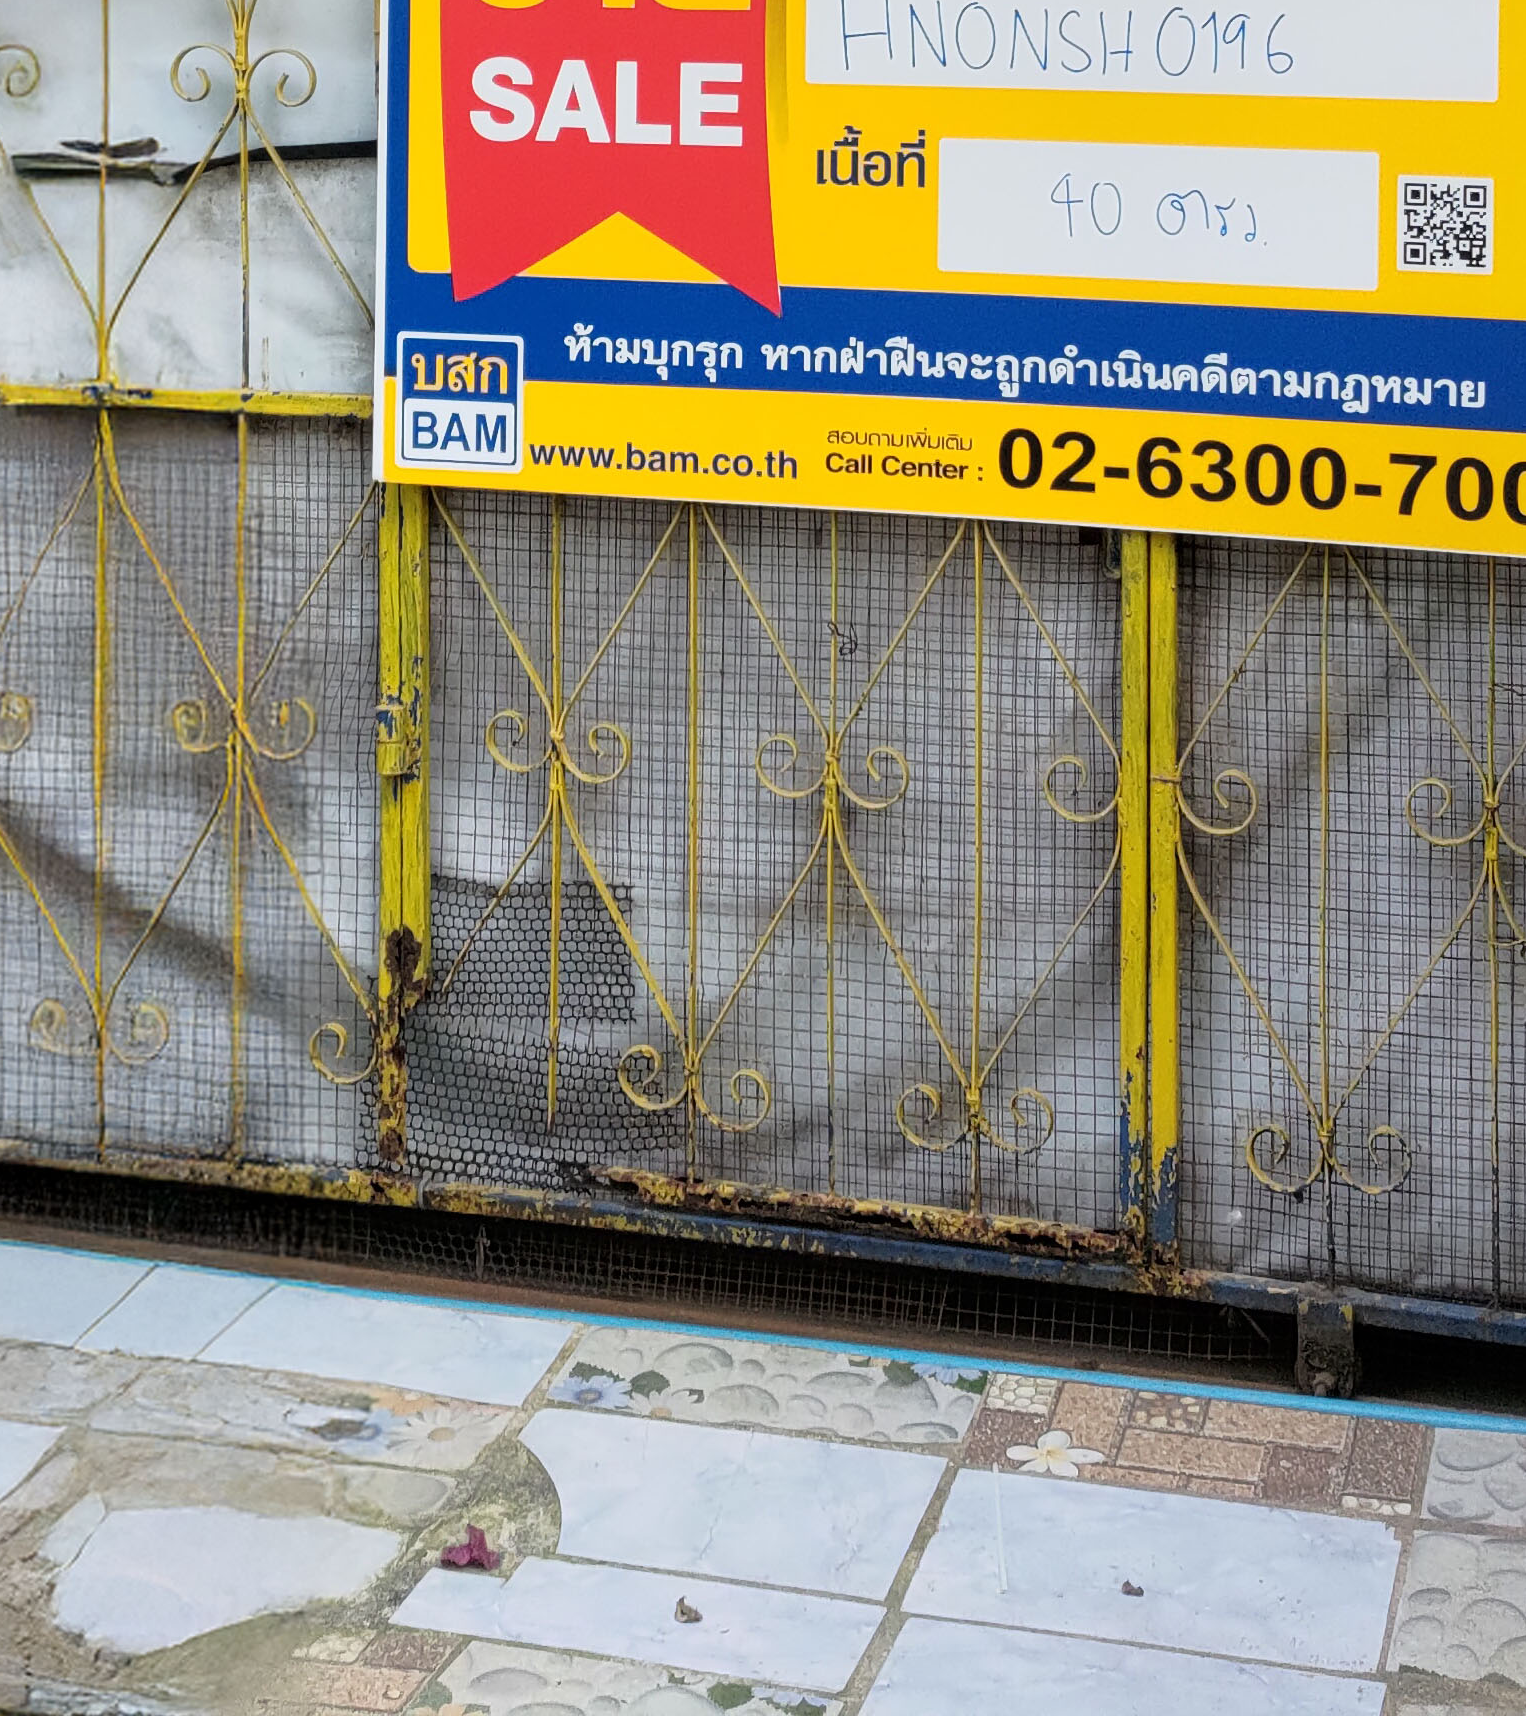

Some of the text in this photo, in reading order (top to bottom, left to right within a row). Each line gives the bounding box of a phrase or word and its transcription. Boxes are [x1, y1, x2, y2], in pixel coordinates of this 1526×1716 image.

[469, 56, 743, 147] SALE
[816, 125, 926, 189] เนื้อที่
[1050, 172, 1122, 237] 40
[411, 351, 509, 395] บสก
[563, 322, 1486, 414] ห้ามบุกรุก หากฝ่าฝืนจะถูกดำเนินคดีตามกฎหมาย
[412, 410, 508, 454] BAM
[827, 427, 973, 452] สอบถามเพิ่มเติม
[529, 442, 798, 480] www.bam.co.th
[825, 452, 873, 475] Call
